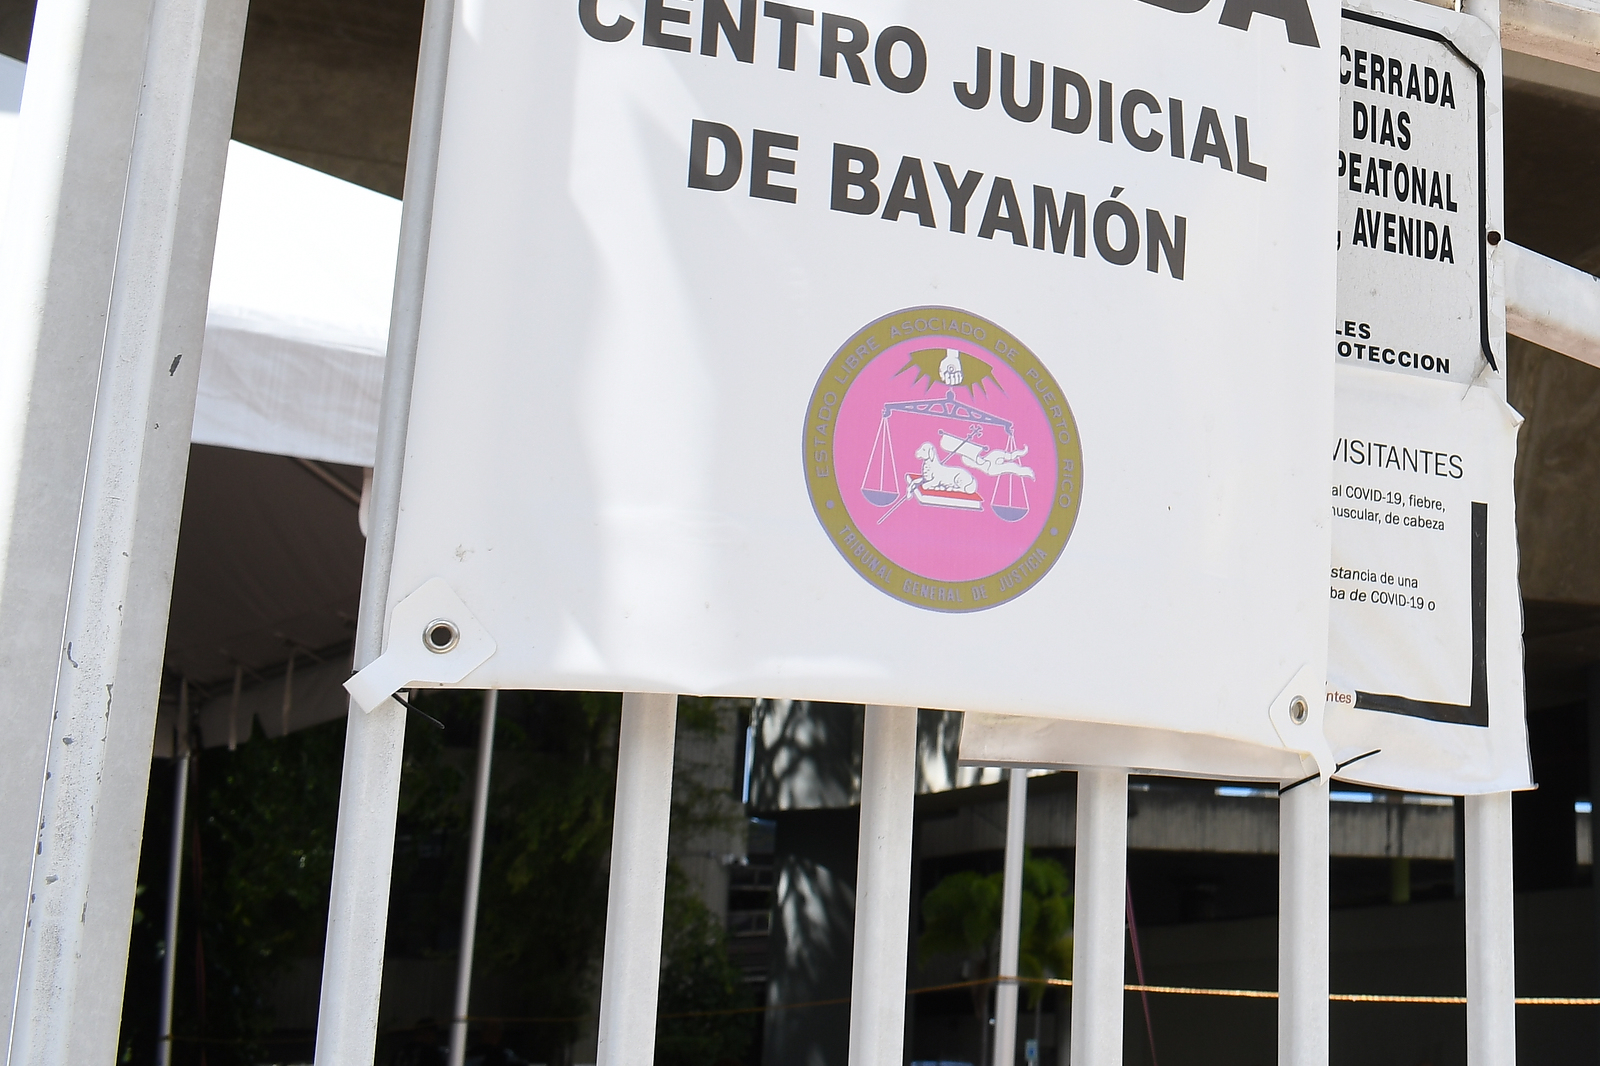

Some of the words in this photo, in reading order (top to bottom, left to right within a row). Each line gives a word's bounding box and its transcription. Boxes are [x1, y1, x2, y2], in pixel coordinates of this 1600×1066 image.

[1340, 45, 1456, 110] CERRADA
[954, 46, 1268, 182] JUDICIAL
[1353, 101, 1411, 151] DIAS
[687, 119, 799, 204] DE
[830, 142, 1187, 280] BAYAMÓN
[1352, 207, 1455, 264] AVENIDA
[1337, 341, 1450, 374] OTECCION
[814, 391, 838, 478] ESTADO
[834, 336, 881, 385] LIBRE
[890, 317, 987, 341] ASOCIADO
[994, 339, 1020, 363] DE
[1025, 367, 1071, 445] PUERTO
[1058, 458, 1075, 509] RICO
[1345, 485, 1406, 507] COVID-19,
[1409, 494, 1446, 513] fiebre,
[1385, 512, 1400, 525] de
[1403, 516, 1445, 531] cabeza
[839, 524, 893, 584] TRIBUNAL
[901, 578, 963, 603] GENERAL
[970, 585, 989, 602] DE
[998, 547, 1048, 592] JUSTICIA
[1380, 571, 1394, 585] de
[1398, 576, 1418, 589] una
[1349, 588, 1367, 602] de
[1371, 590, 1424, 610] COVID-19
[1427, 600, 1436, 611] o
